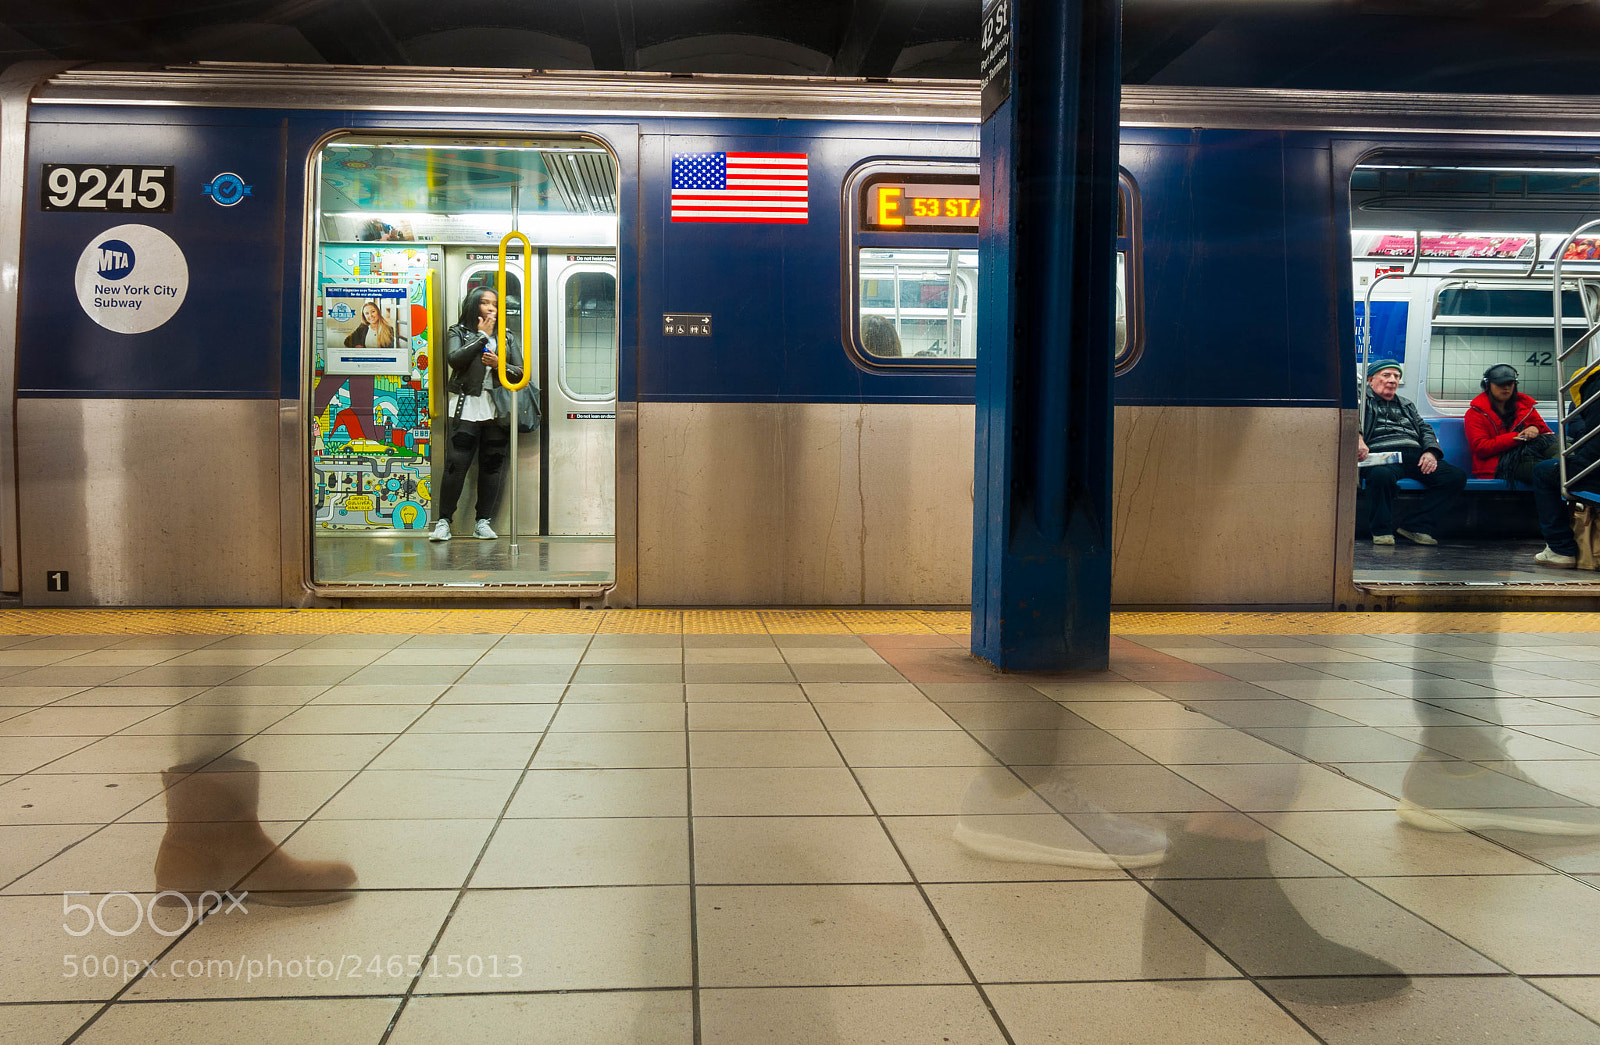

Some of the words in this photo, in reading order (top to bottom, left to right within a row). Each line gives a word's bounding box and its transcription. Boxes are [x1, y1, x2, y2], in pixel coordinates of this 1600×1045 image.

[981, 17, 994, 51] 42
[996, 0, 1008, 35] St
[981, 54, 990, 74] Port
[990, 31, 1009, 61] Authority
[989, 50, 1008, 81] Terminal
[48, 168, 166, 208] 9245
[879, 188, 903, 226] E
[914, 198, 939, 217] 53
[97, 248, 129, 272] MTA
[94, 284, 121, 295] New
[123, 285, 150, 295] York
[153, 285, 178, 298] City
[94, 297, 142, 310] Subway
[1526, 351, 1553, 366] 42
[52, 573, 61, 590] 1
